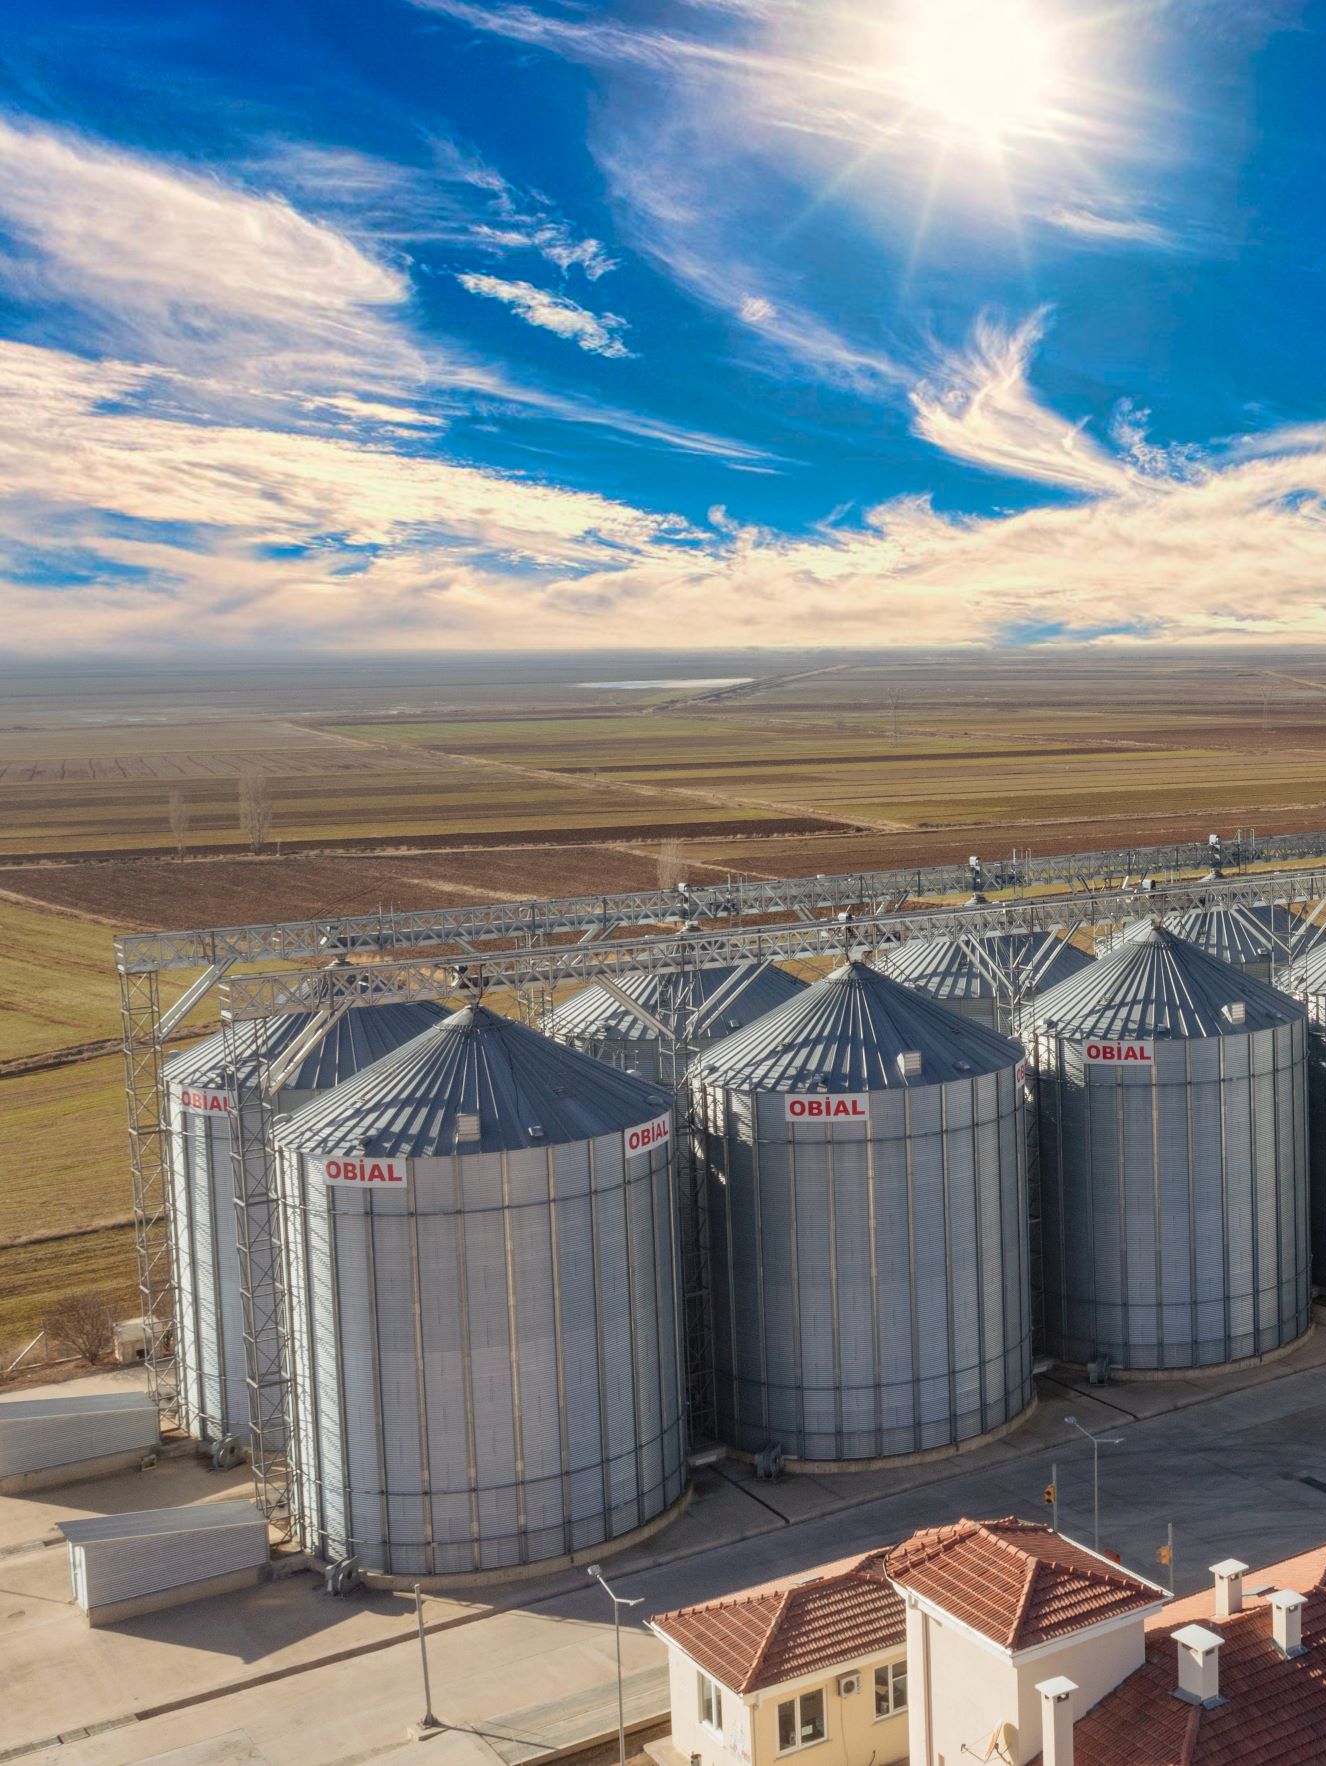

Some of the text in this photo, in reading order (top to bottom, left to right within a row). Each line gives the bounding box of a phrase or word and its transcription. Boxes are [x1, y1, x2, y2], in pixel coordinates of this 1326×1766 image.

[1086, 1042, 1152, 1061] OBİAL
[789, 1097, 866, 1117] OBİAL
[628, 1120, 669, 1150] OBİAL
[325, 1159, 403, 1182] OBİAL
